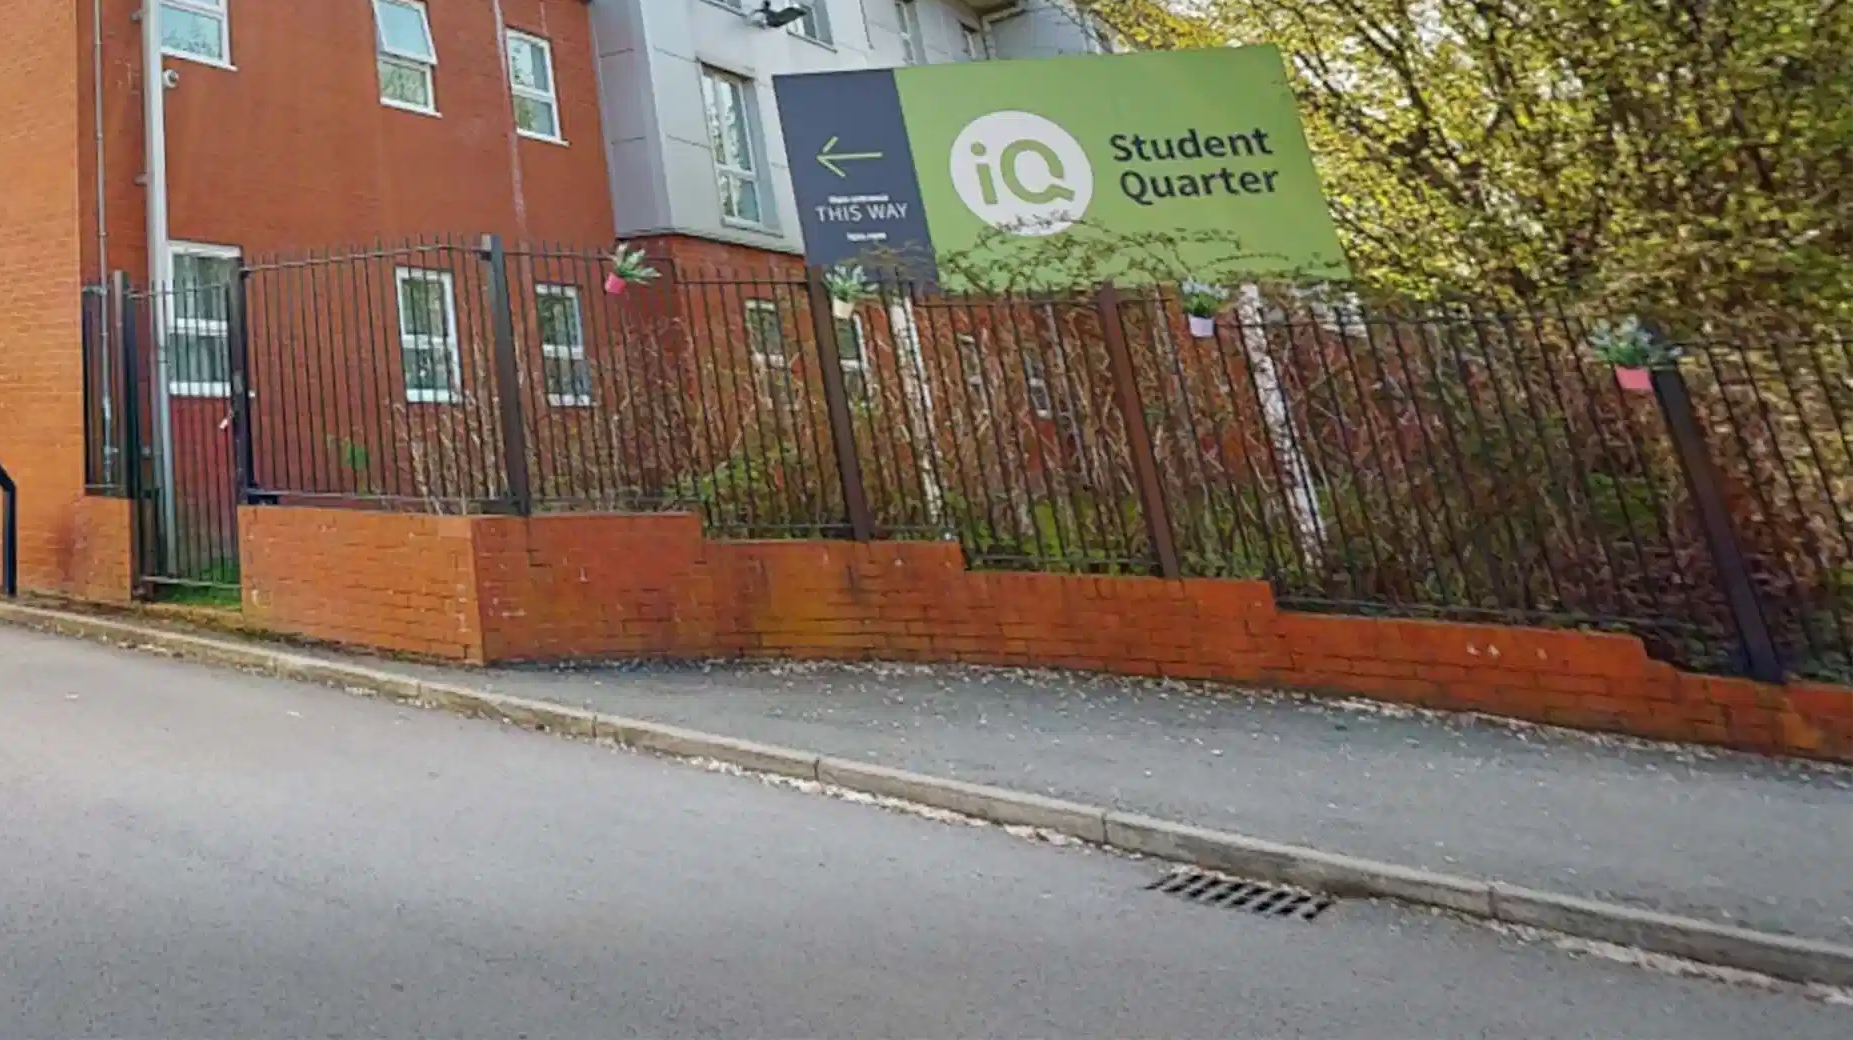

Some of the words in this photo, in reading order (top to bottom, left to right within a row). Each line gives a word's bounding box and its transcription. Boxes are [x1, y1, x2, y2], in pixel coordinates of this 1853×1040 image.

[1108, 127, 1274, 163] Student
[970, 138, 1076, 205] iQ
[1119, 166, 1280, 206] Quarter
[814, 203, 863, 223] THIS
[866, 202, 908, 220] WAY
